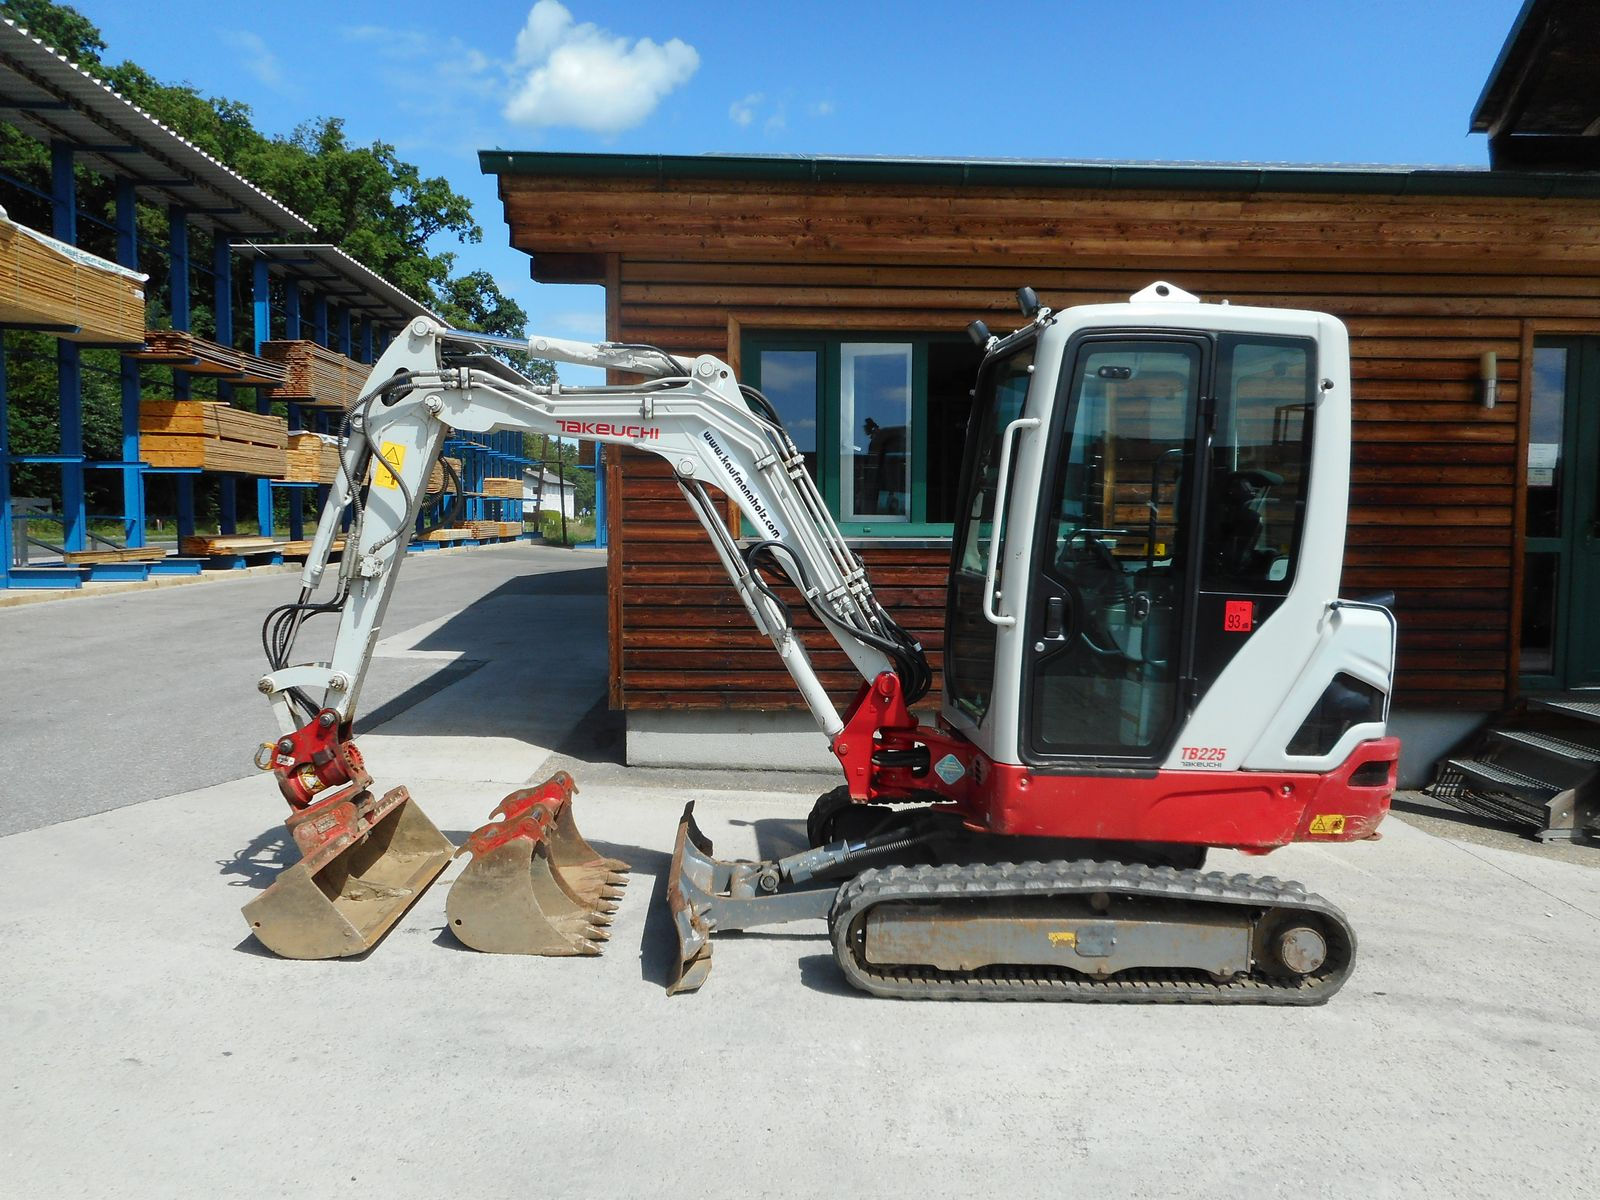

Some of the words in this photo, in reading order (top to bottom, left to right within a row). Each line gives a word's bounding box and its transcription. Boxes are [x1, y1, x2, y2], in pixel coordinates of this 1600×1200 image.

[703, 431, 780, 539] www.kaufmannholz.com
[1228, 614, 1241, 629] 93
[1181, 747, 1227, 761] TB225
